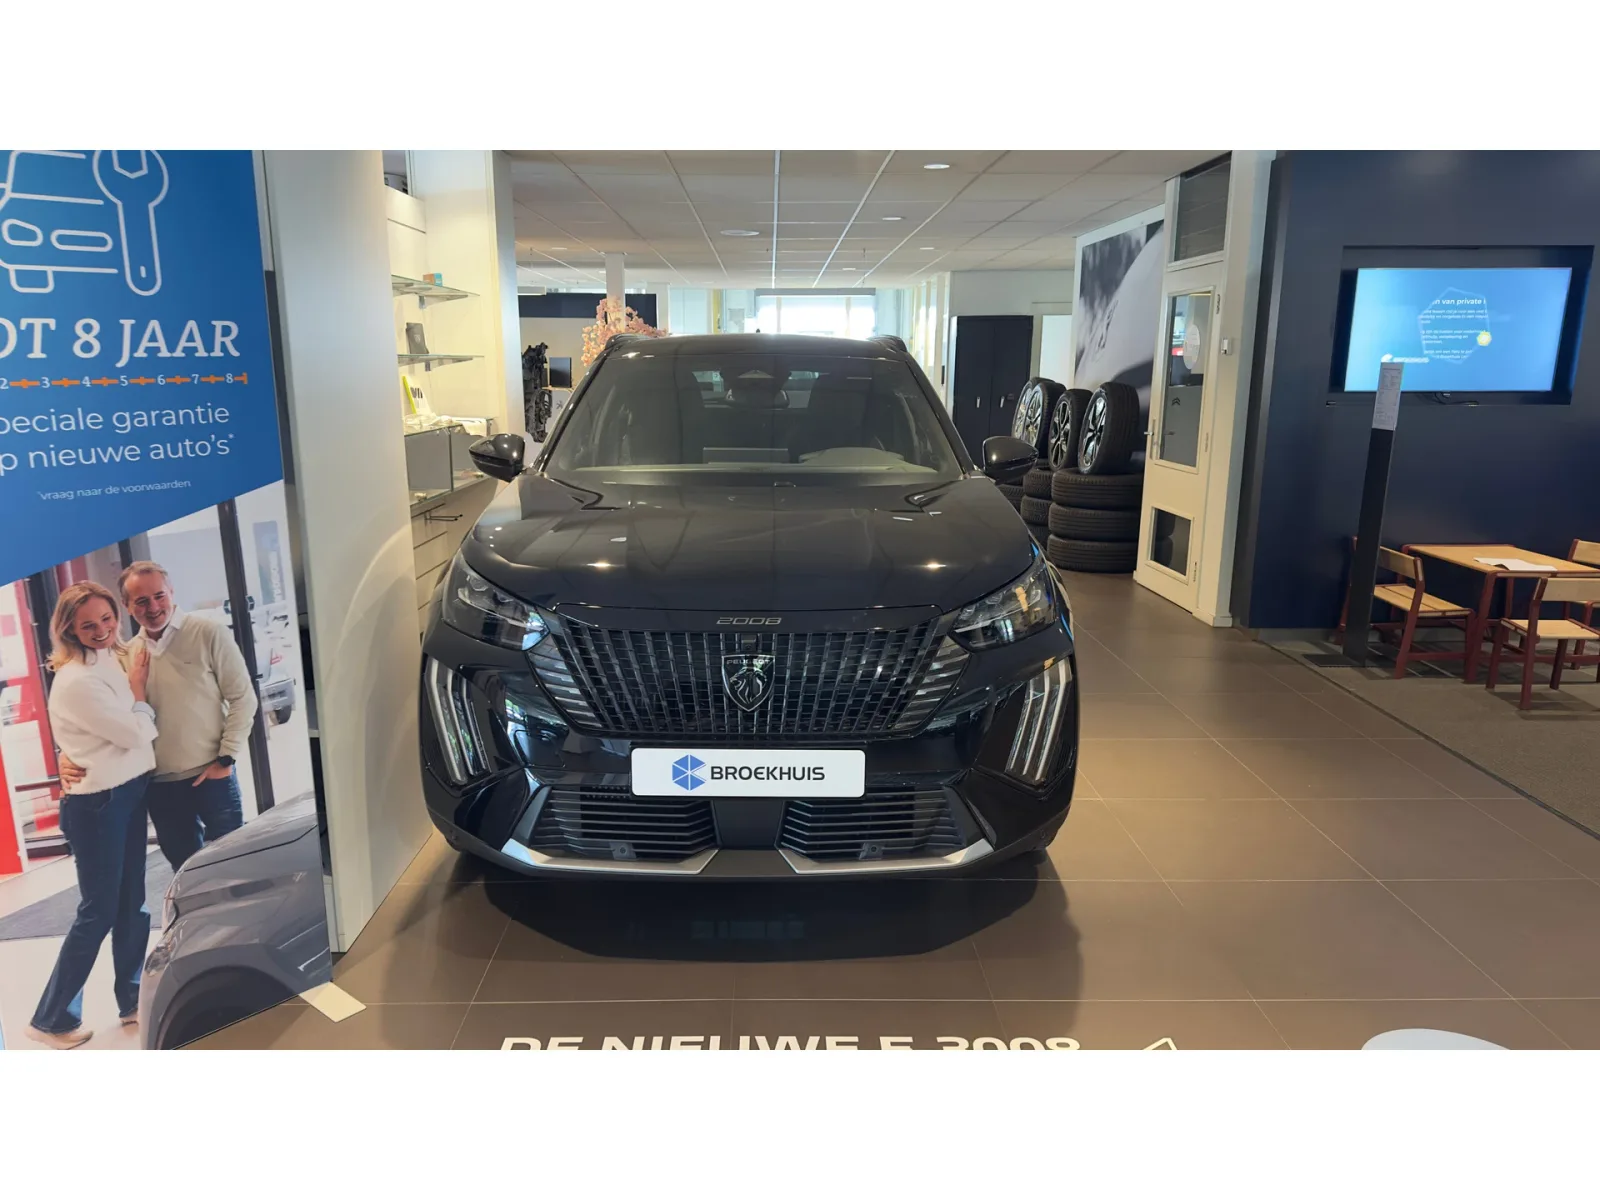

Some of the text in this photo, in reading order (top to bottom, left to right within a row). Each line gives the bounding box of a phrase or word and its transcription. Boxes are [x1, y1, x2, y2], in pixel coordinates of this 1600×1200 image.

[1456, 297, 1482, 306] private
[72, 318, 101, 359] 8
[115, 319, 241, 368] JAAR
[0, 372, 234, 390] 2 3 4 5 6 7 8
[112, 402, 230, 434] garantie
[28, 444, 141, 469] nieuwe
[76, 487, 103, 497] naar
[104, 485, 120, 495] de
[121, 480, 192, 493] voorwaarden
[716, 616, 782, 626] 2008
[710, 765, 826, 781] BROEKHUIS
